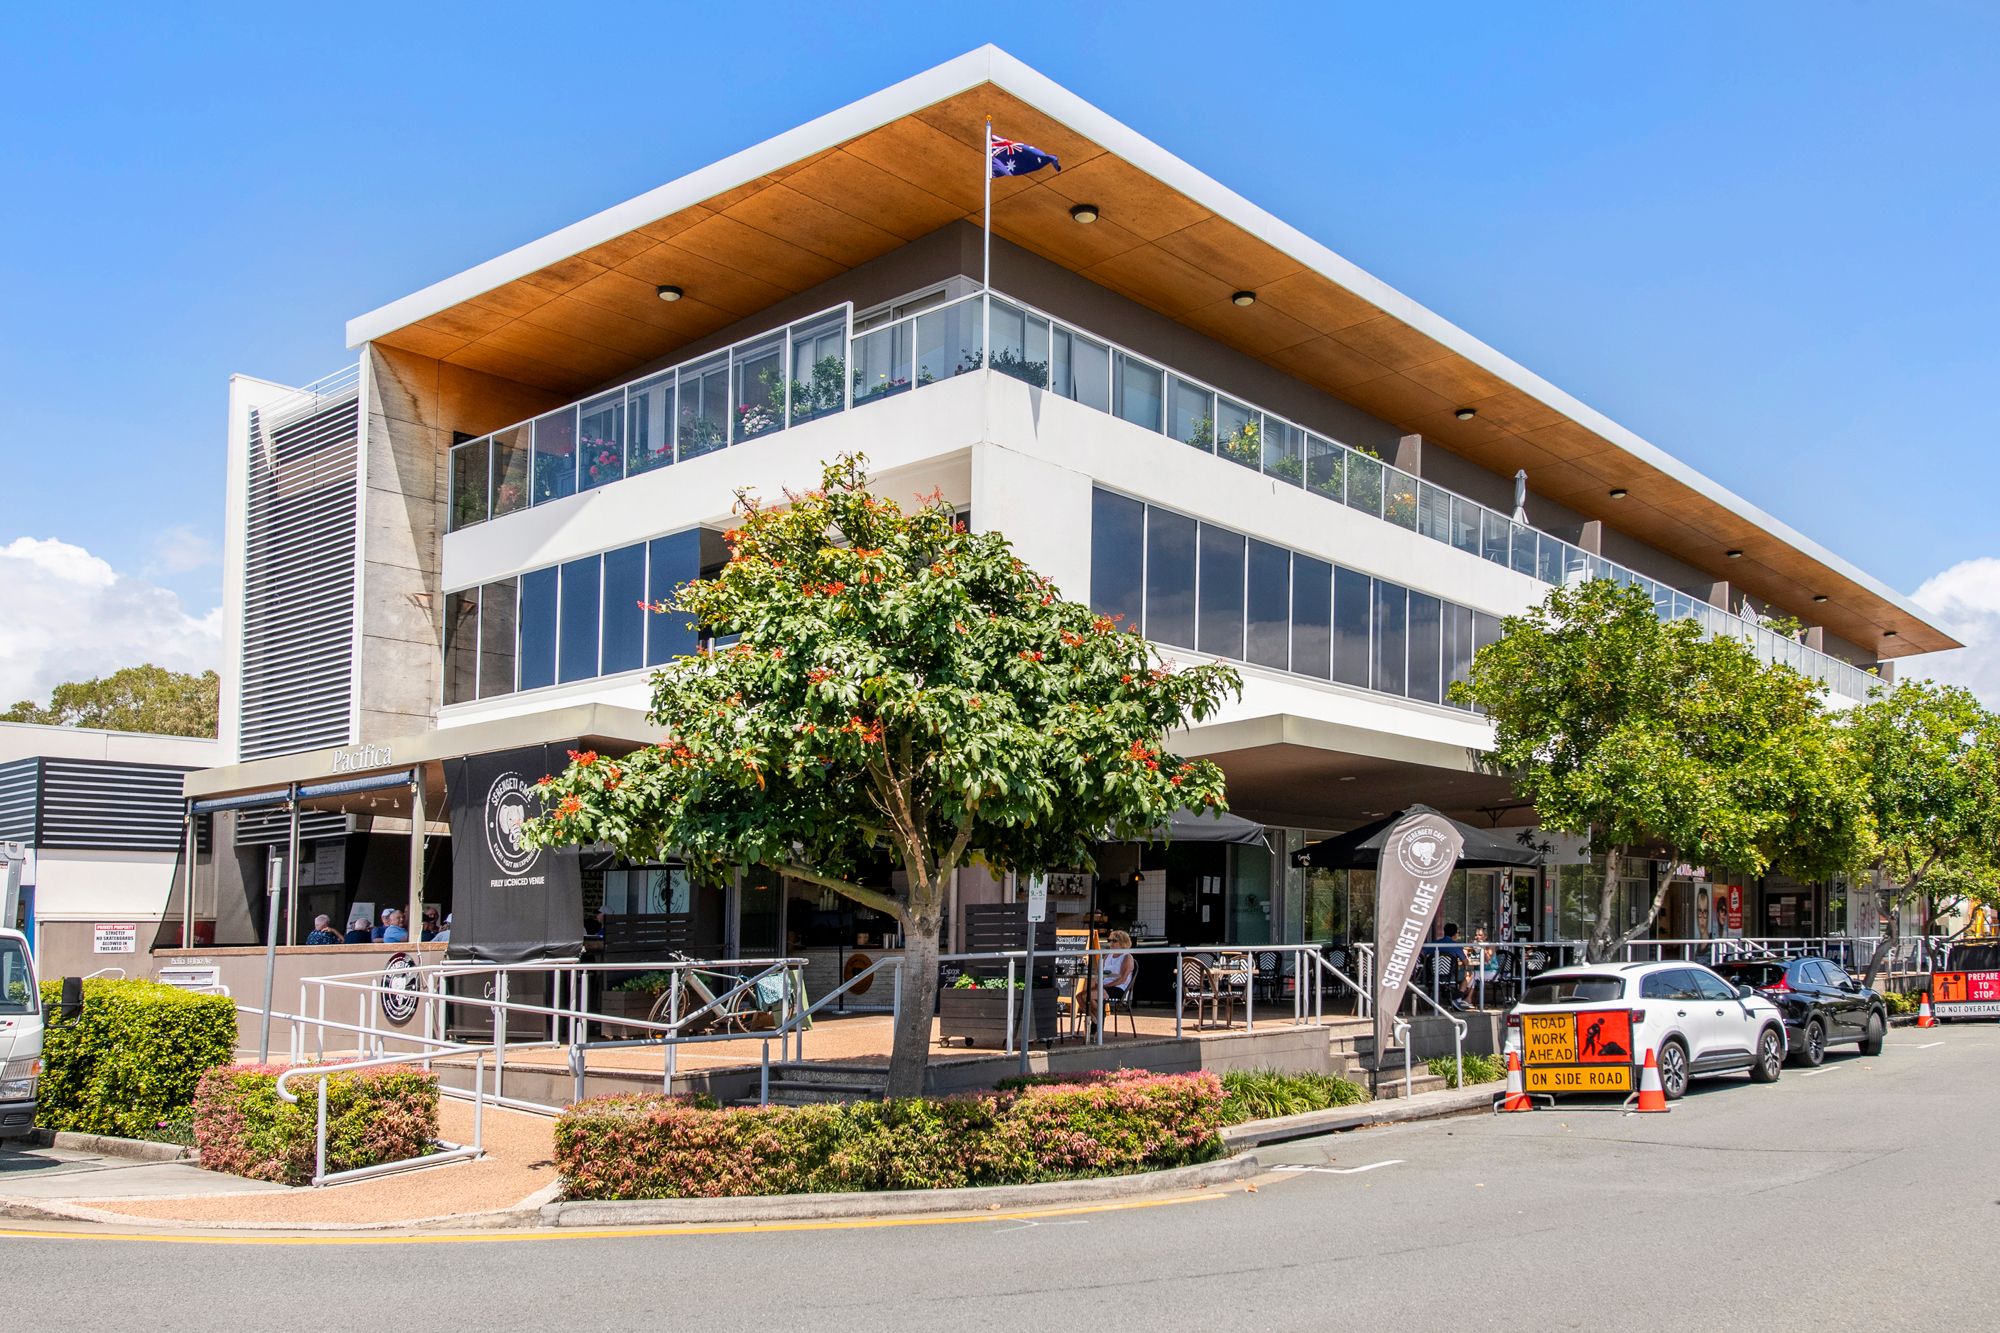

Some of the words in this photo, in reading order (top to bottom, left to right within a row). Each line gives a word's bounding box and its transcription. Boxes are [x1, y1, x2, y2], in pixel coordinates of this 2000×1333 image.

[332, 744, 392, 773] Pacifica
[491, 778, 518, 807] SERENGETI
[1405, 828, 1434, 843] SERENGETI
[493, 843, 504, 861] EVERY
[503, 858, 513, 868] VISIT
[490, 879, 504, 887] FULLY
[504, 878, 529, 887] LICENCED
[528, 876, 545, 885] VENUE
[1381, 917, 1424, 990] SERENGETI
[1410, 880, 1438, 916] CAFE
[1967, 972, 1999, 981] PREPARE
[1979, 982, 1989, 990] TO
[1973, 991, 1994, 999] STOP
[1964, 1005, 2000, 1013] OVERTAKE
[1531, 1017, 1566, 1029] ROAD
[1531, 1033, 1567, 1045] WORK
[1528, 1048, 1573, 1061] AHEAD
[1532, 1073, 1547, 1085] ON
[1555, 1073, 1582, 1085] SIDE
[1590, 1072, 1623, 1085] ROAD
